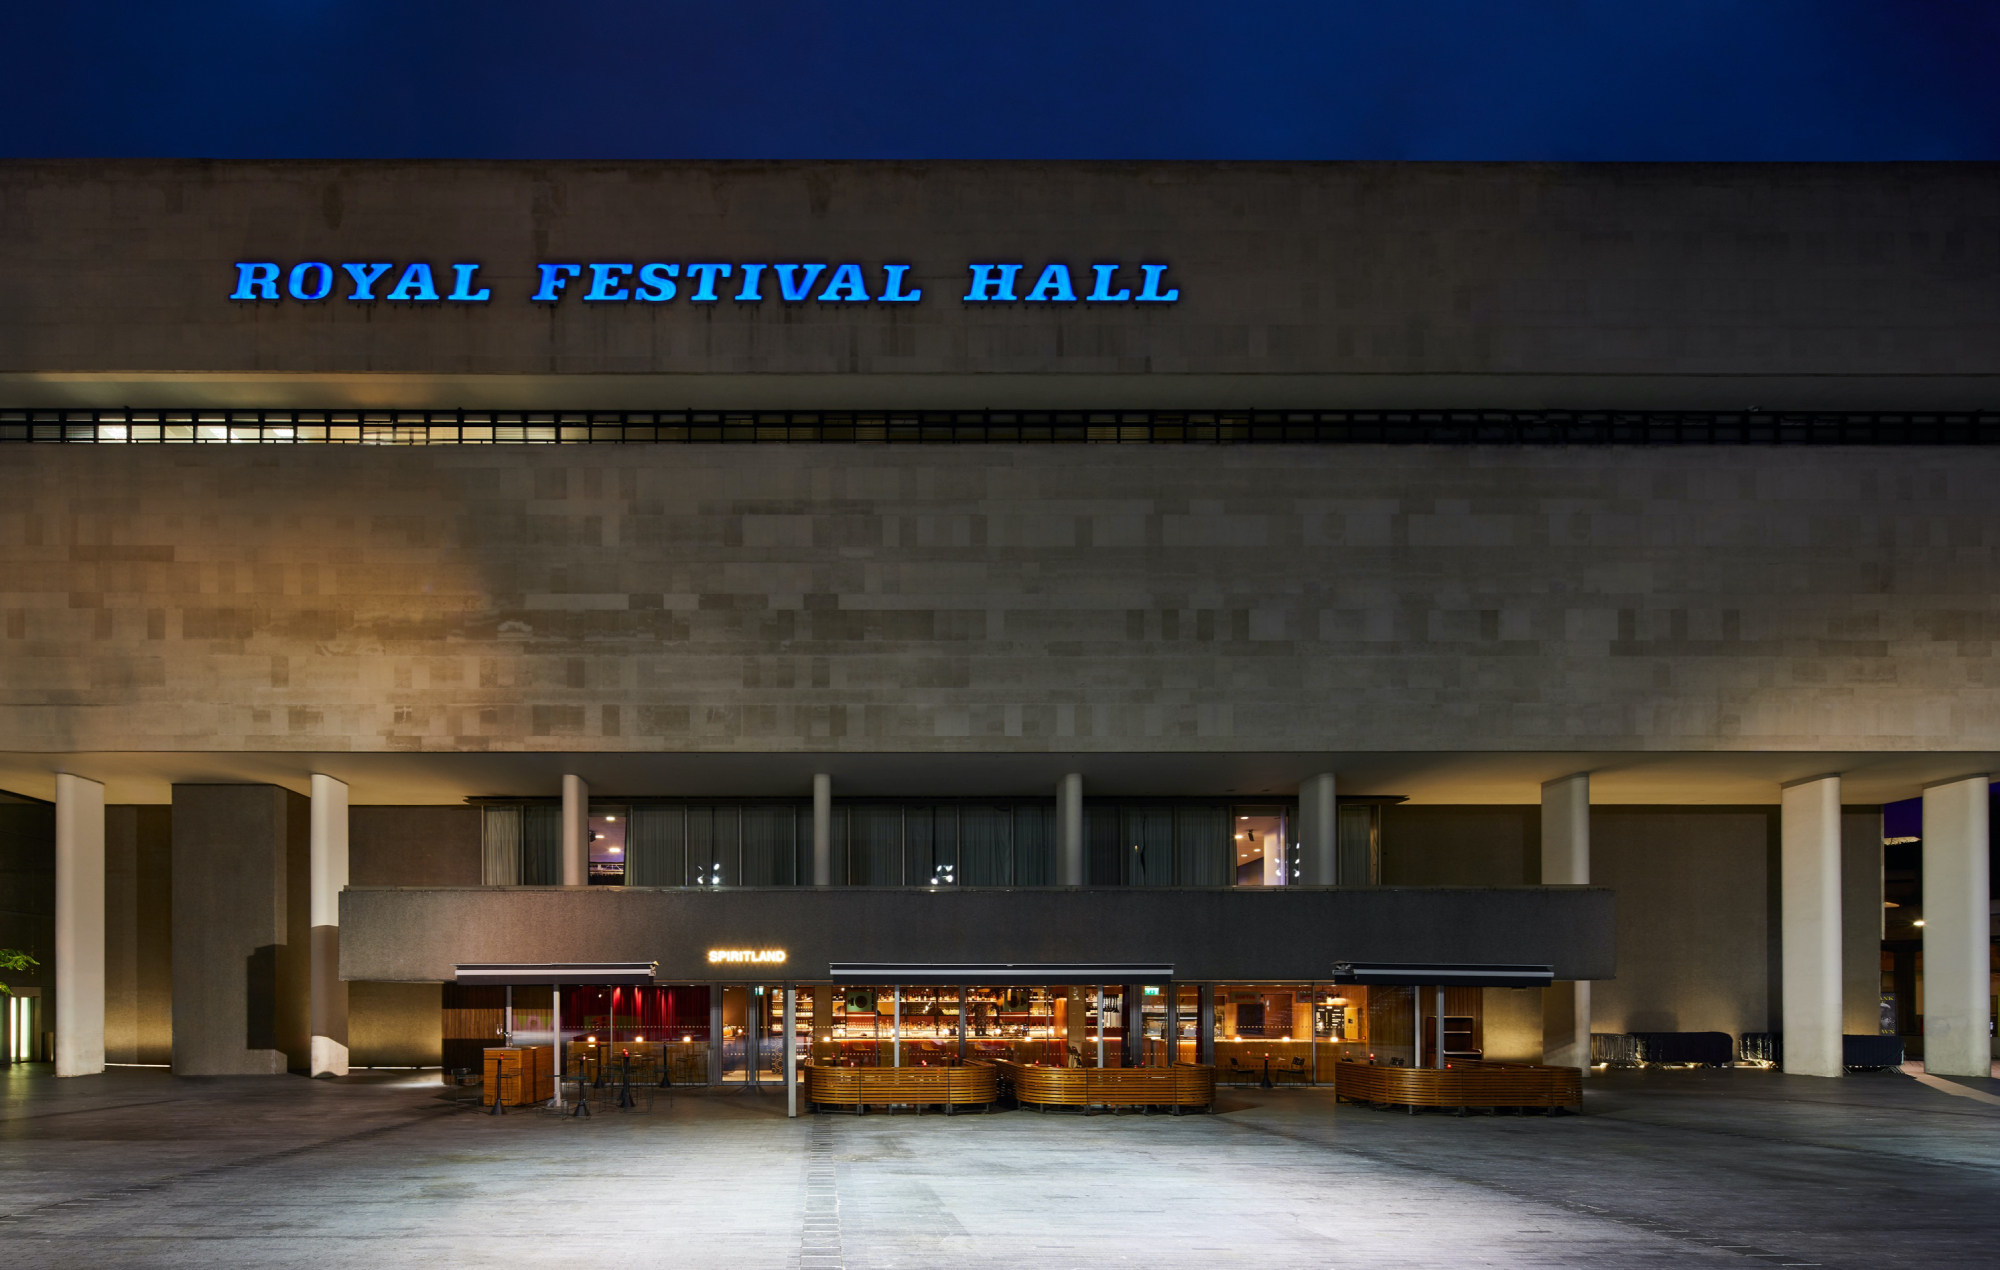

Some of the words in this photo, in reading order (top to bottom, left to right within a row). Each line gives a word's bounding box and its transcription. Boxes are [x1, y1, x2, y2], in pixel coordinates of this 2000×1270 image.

[229, 261, 490, 301] ROYAL
[531, 262, 922, 302] FESTIVAL
[963, 263, 1179, 302] HALL
[708, 950, 786, 963] SPIRITLAND
